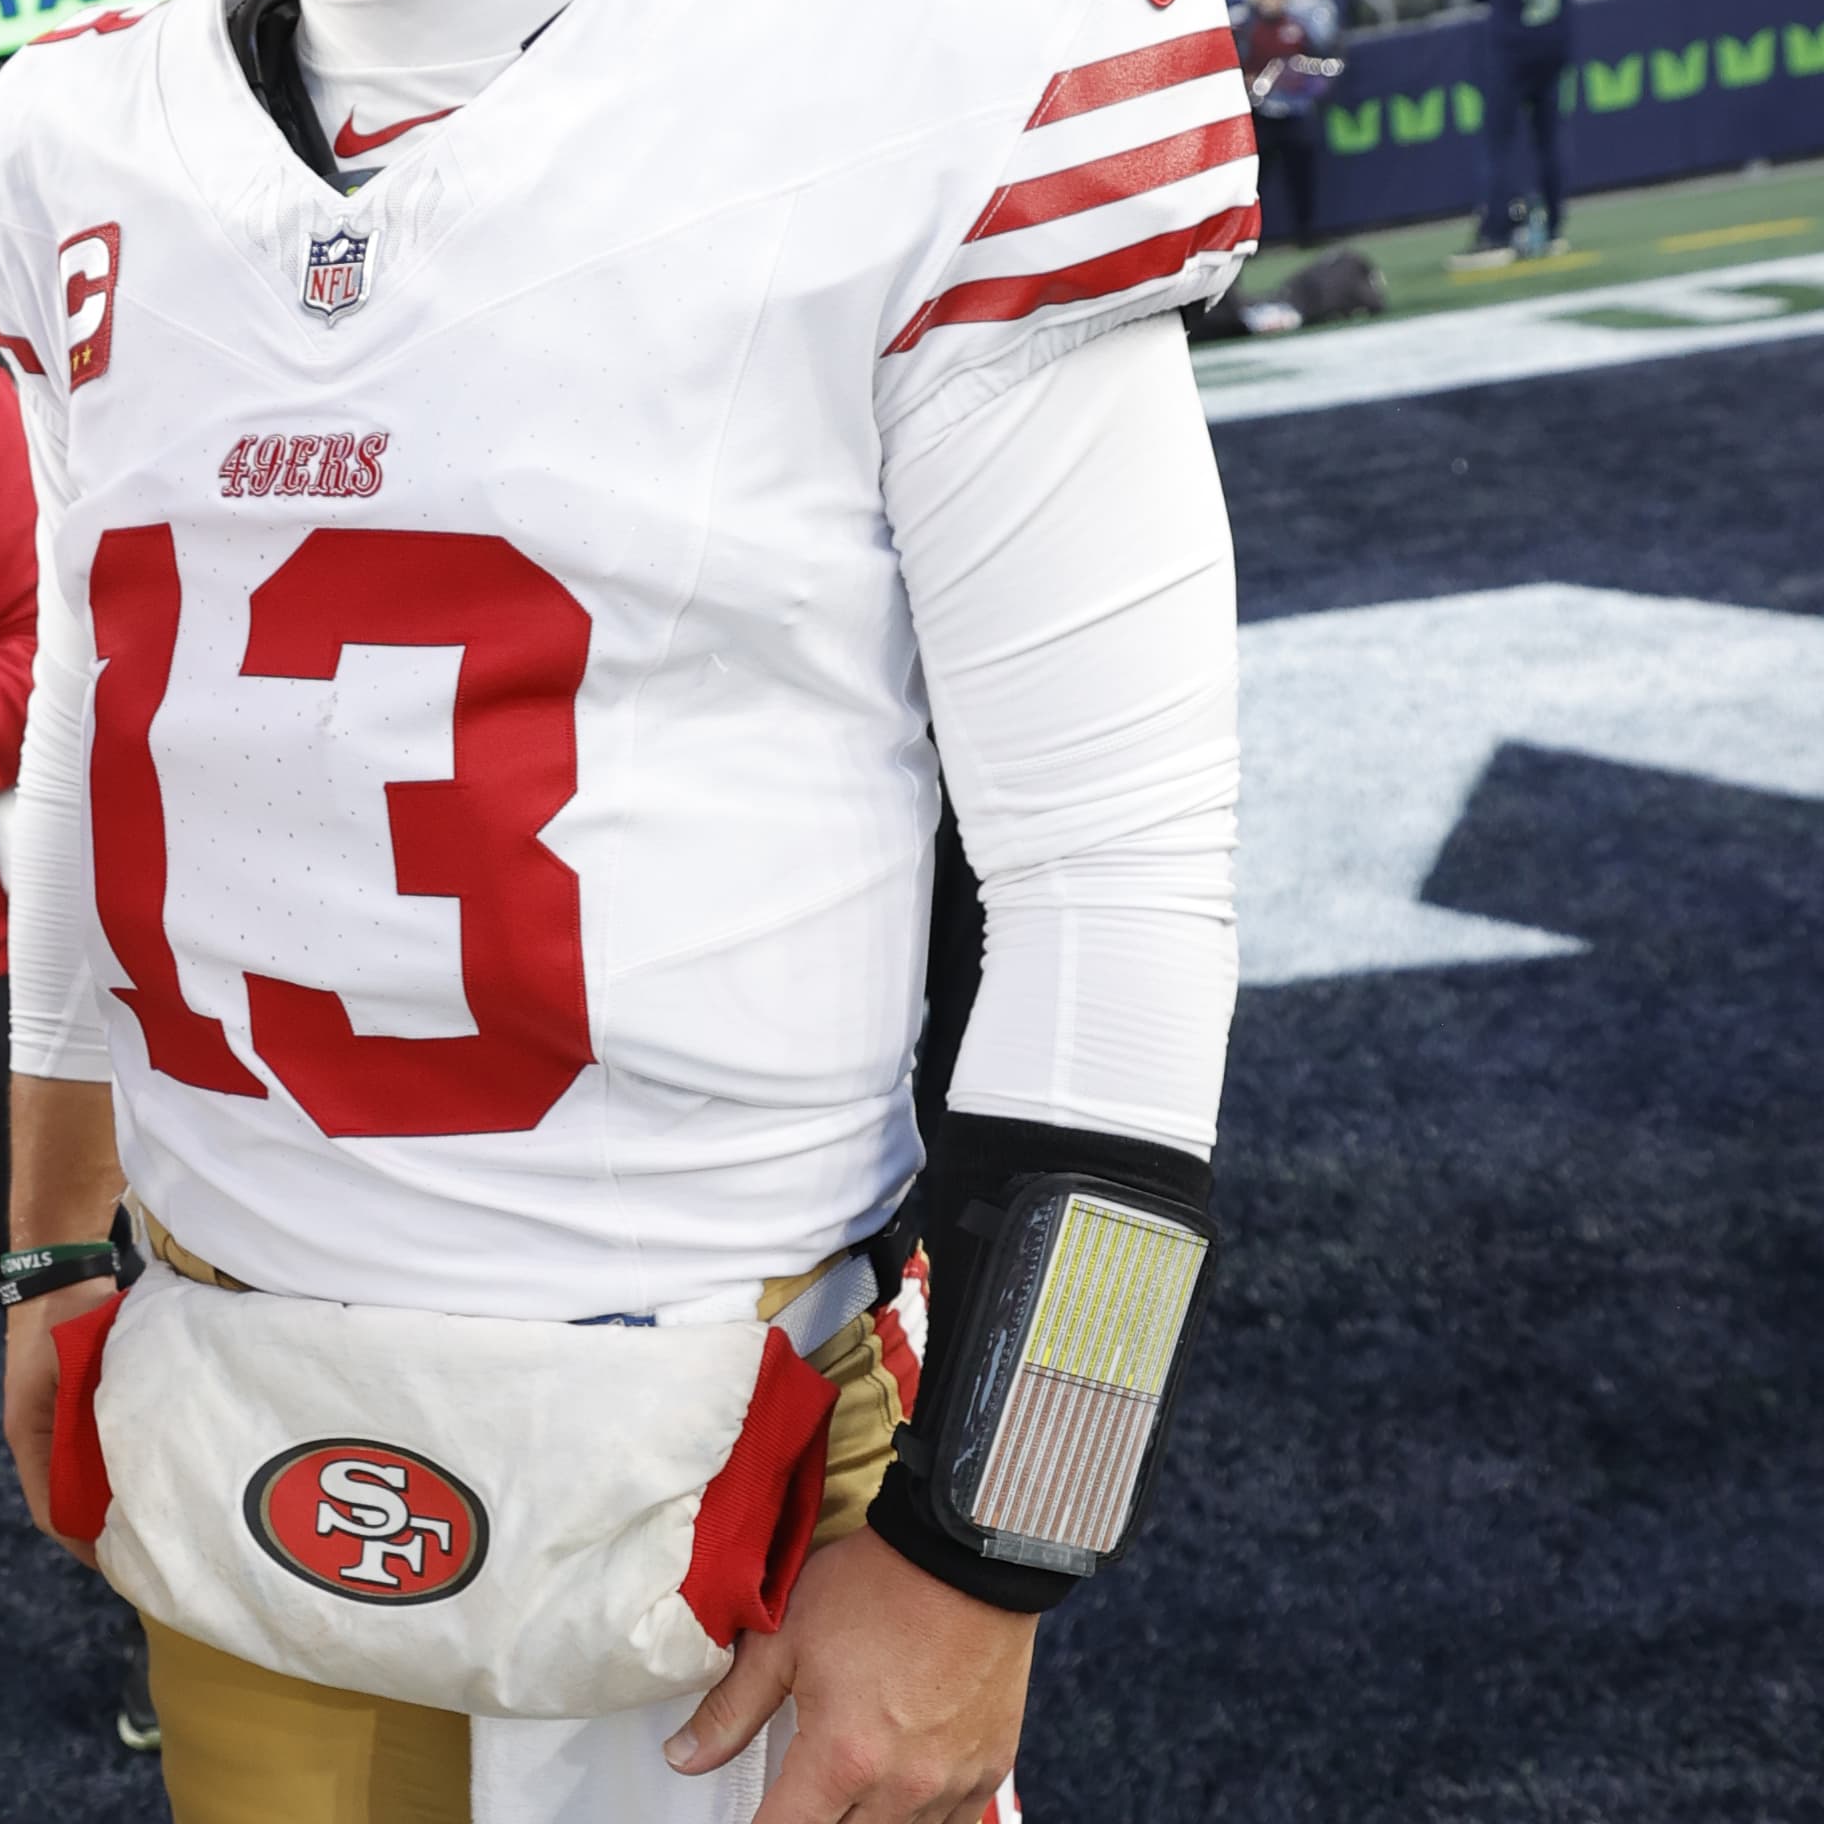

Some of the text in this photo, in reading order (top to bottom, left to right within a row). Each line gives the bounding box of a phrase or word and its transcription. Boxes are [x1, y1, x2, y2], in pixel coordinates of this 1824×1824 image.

[59, 235, 111, 350] C
[309, 266, 356, 305] NFL
[218, 431, 390, 498] 49ERS
[89, 522, 599, 1139] 13
